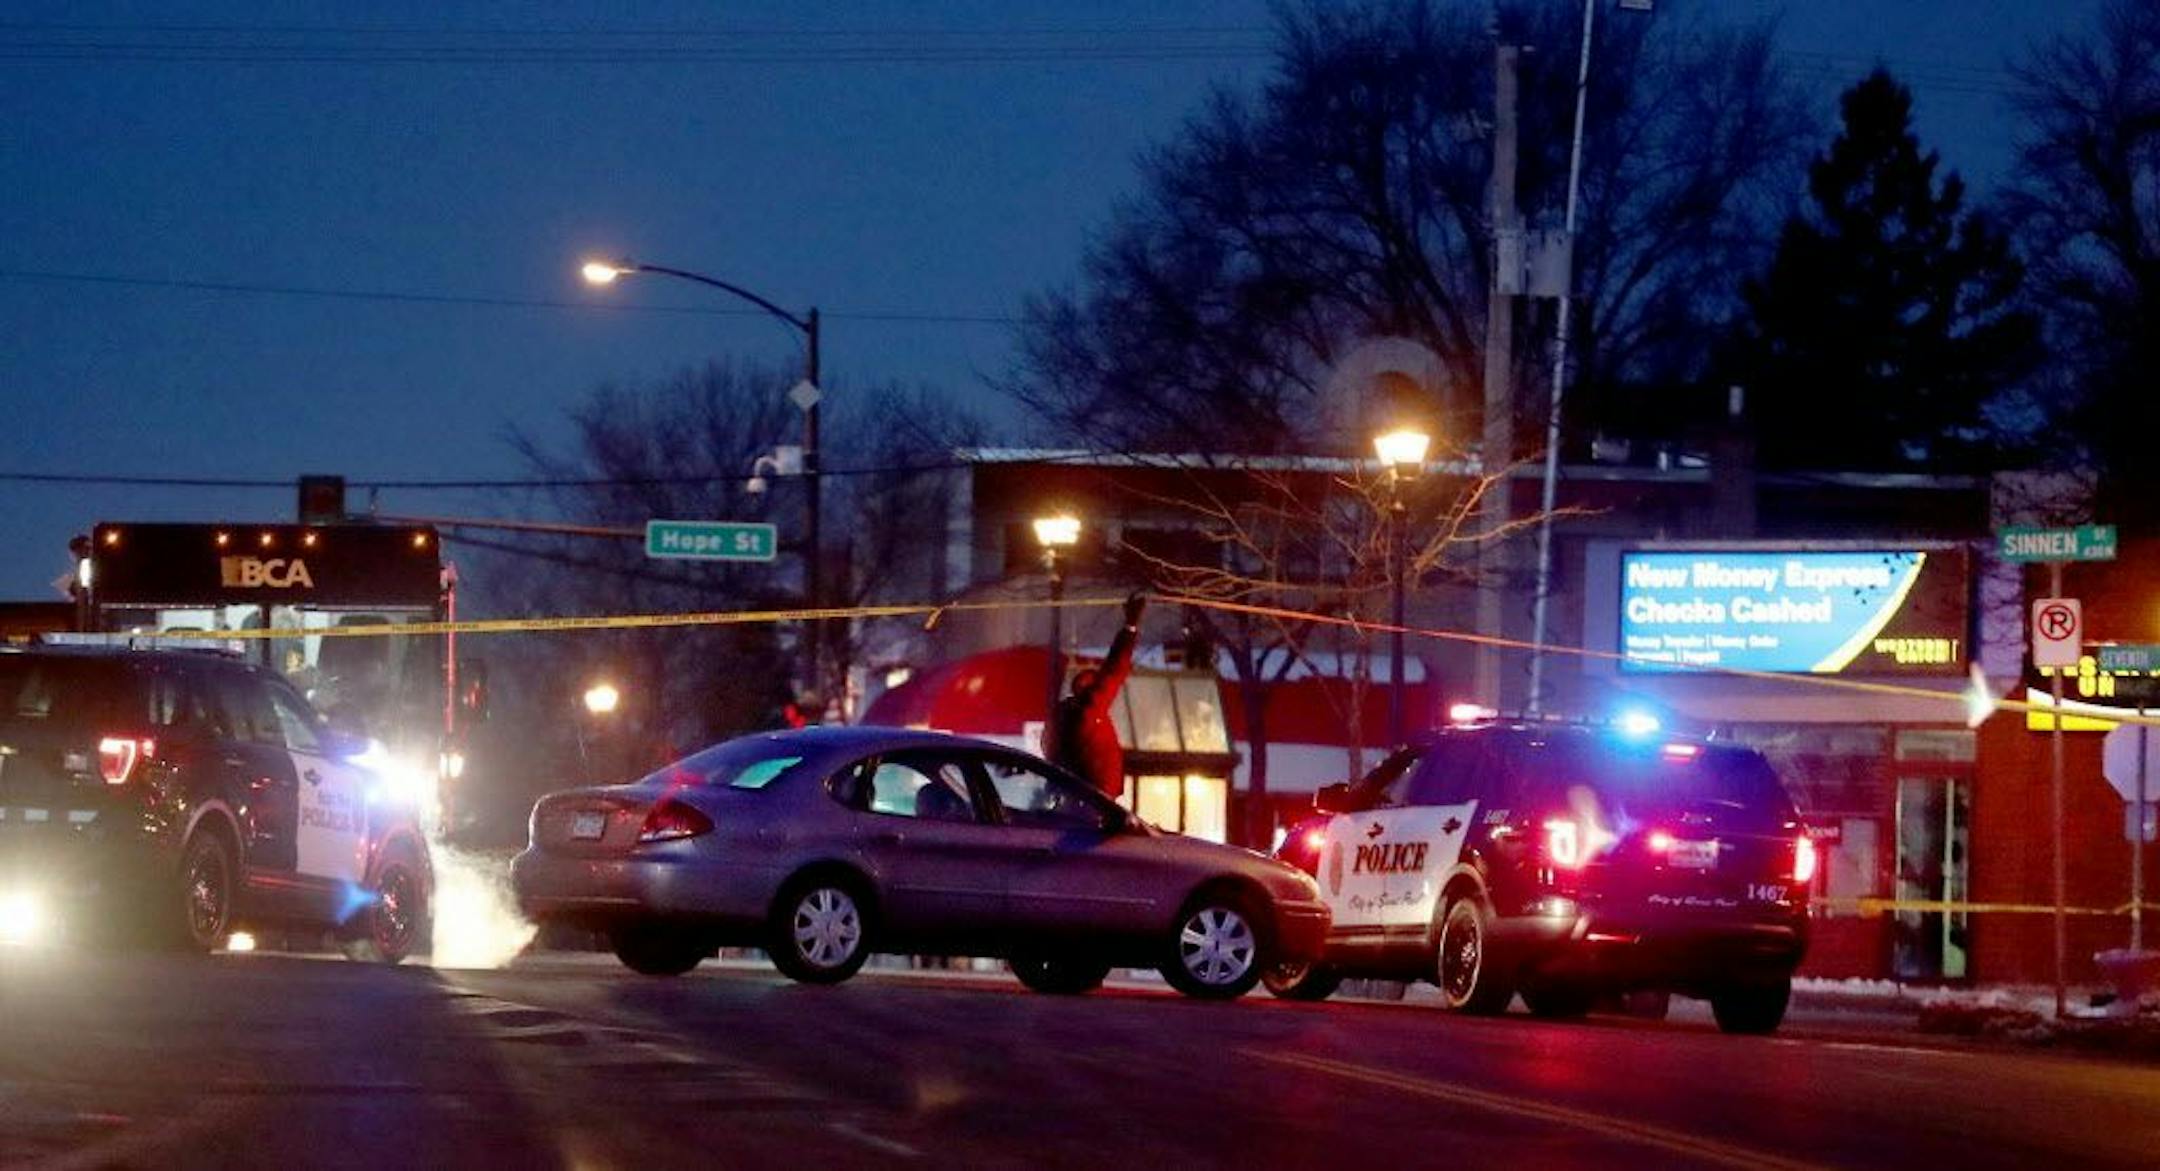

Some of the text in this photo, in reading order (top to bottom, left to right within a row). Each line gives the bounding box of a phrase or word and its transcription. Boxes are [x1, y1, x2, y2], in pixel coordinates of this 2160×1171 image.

[662, 530, 761, 553] Hope St
[2004, 532, 2078, 555] SINNEN
[241, 558, 314, 588] BCA
[1627, 560, 1891, 592] New Money Express
[1627, 596, 1832, 623] Checks Cashed
[1353, 842, 1429, 873] POLICE
[1748, 884, 1788, 901] 1467
